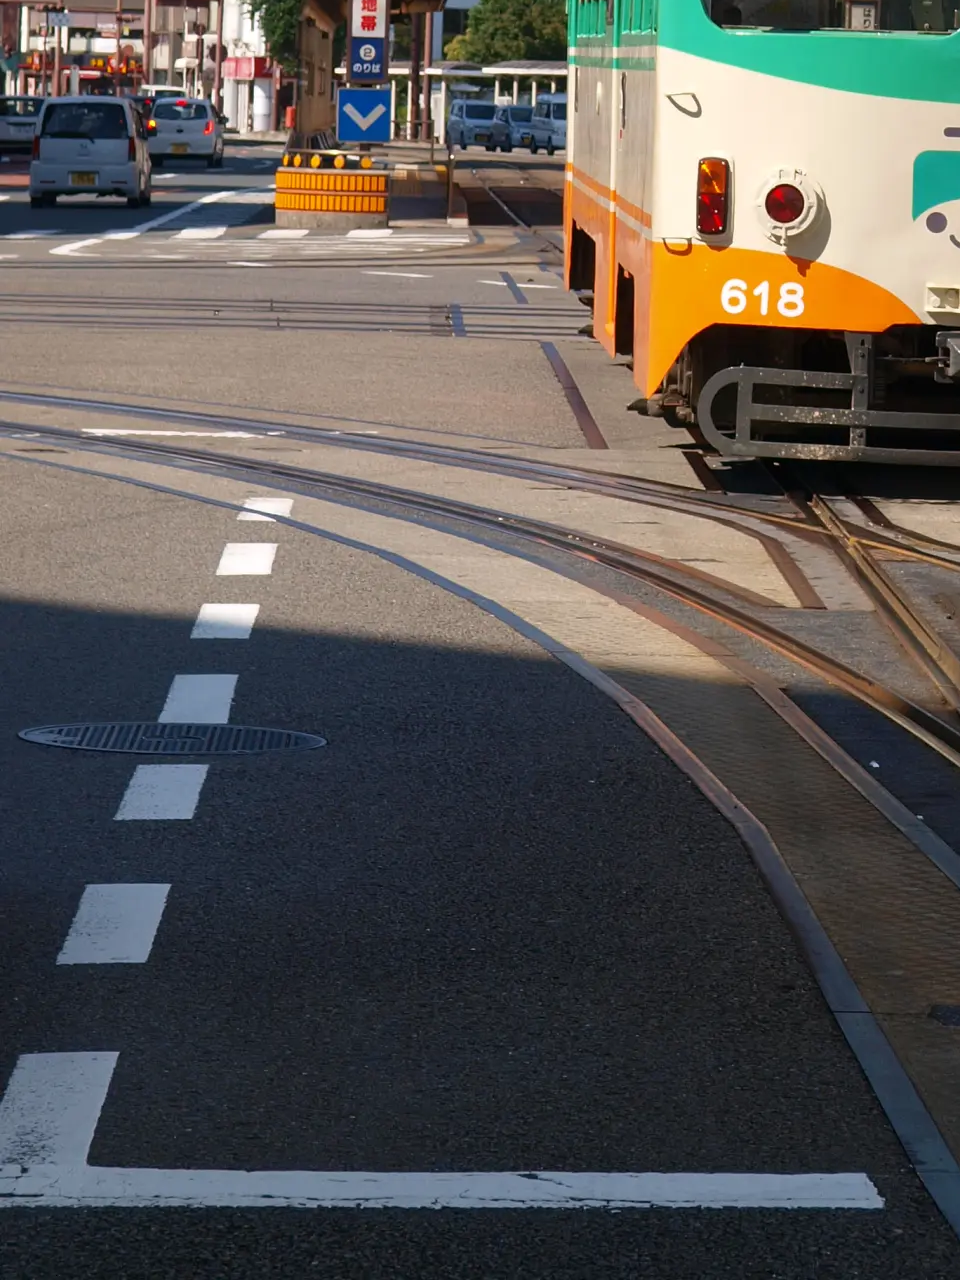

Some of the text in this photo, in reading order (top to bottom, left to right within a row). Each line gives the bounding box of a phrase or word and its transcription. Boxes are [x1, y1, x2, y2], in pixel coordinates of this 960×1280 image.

[352, 63, 381, 73] のりば
[721, 278, 805, 318] 618
